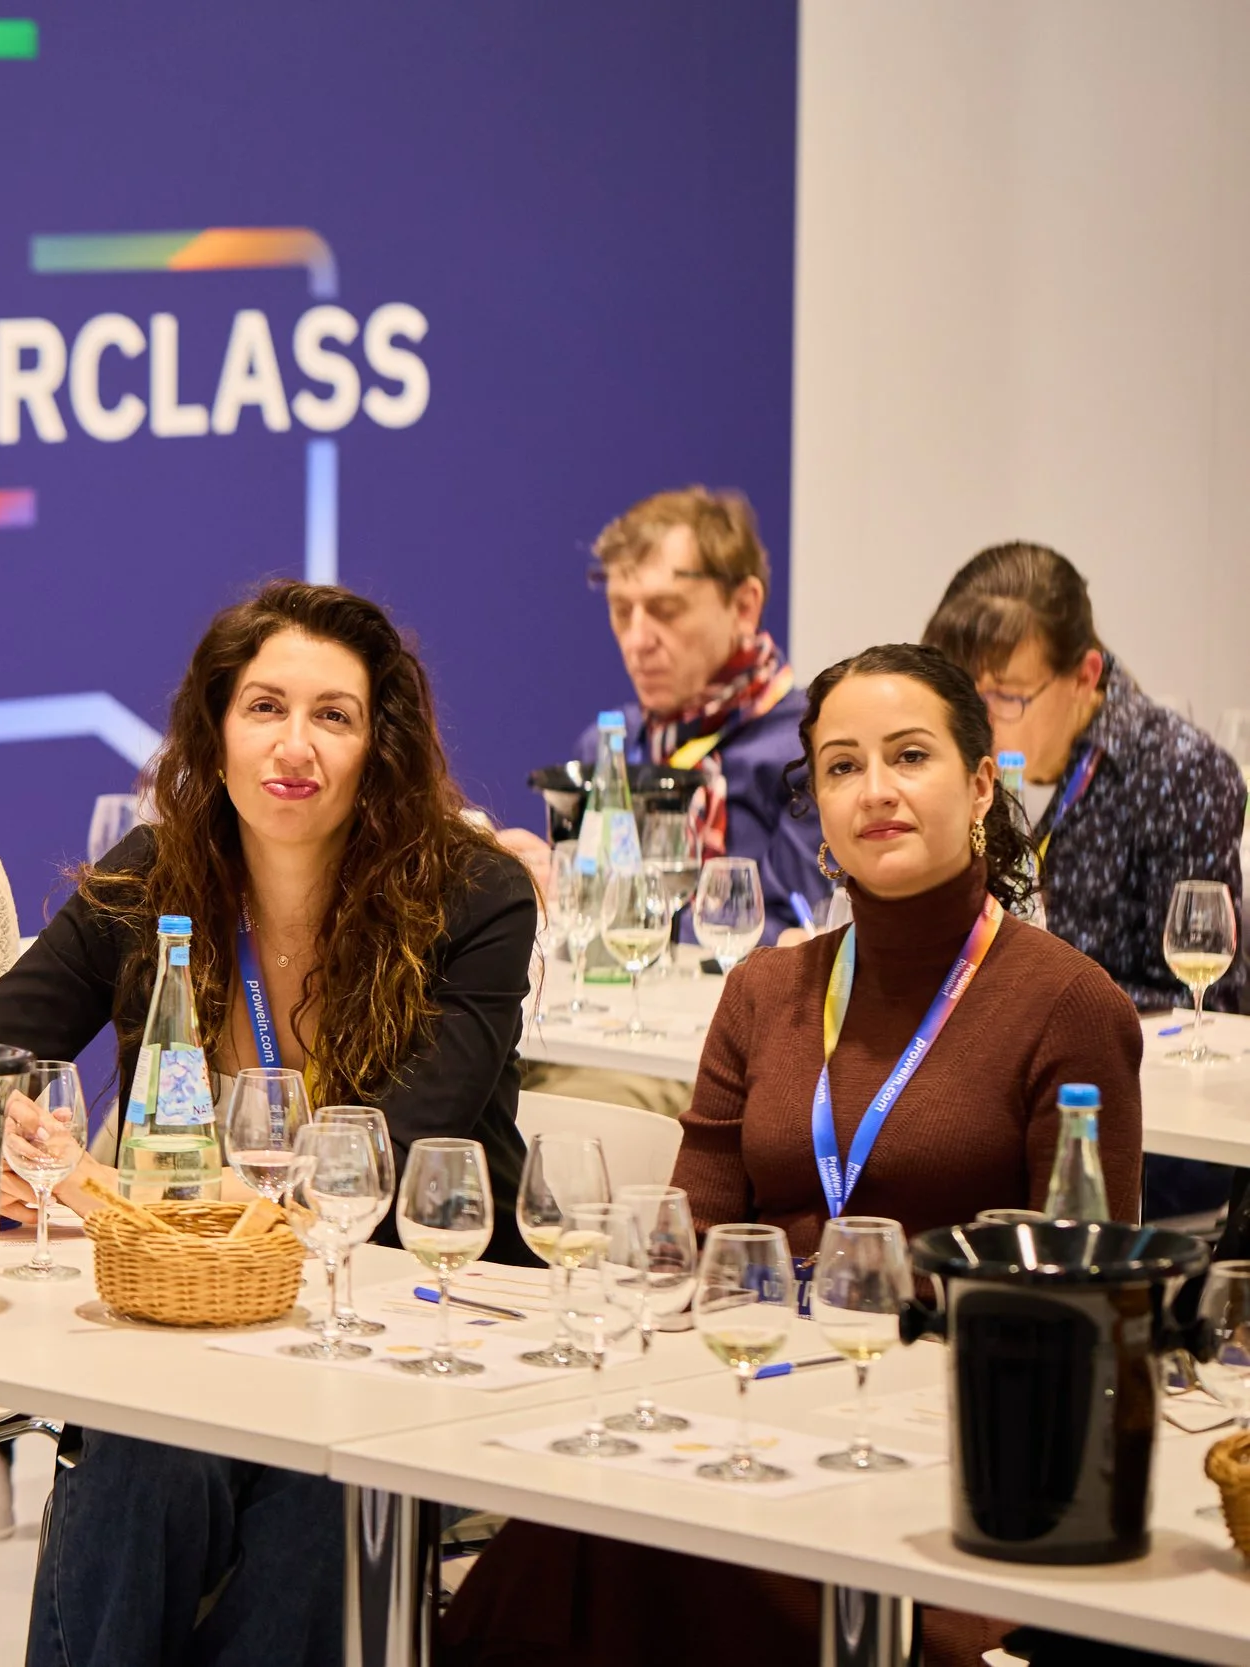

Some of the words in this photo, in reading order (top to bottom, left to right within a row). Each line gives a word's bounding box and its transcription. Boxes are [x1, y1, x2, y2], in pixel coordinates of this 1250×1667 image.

[246, 980, 275, 1063] prowein.com
[874, 1036, 927, 1112] prowein.com
[827, 1155, 843, 1198] ProWein
